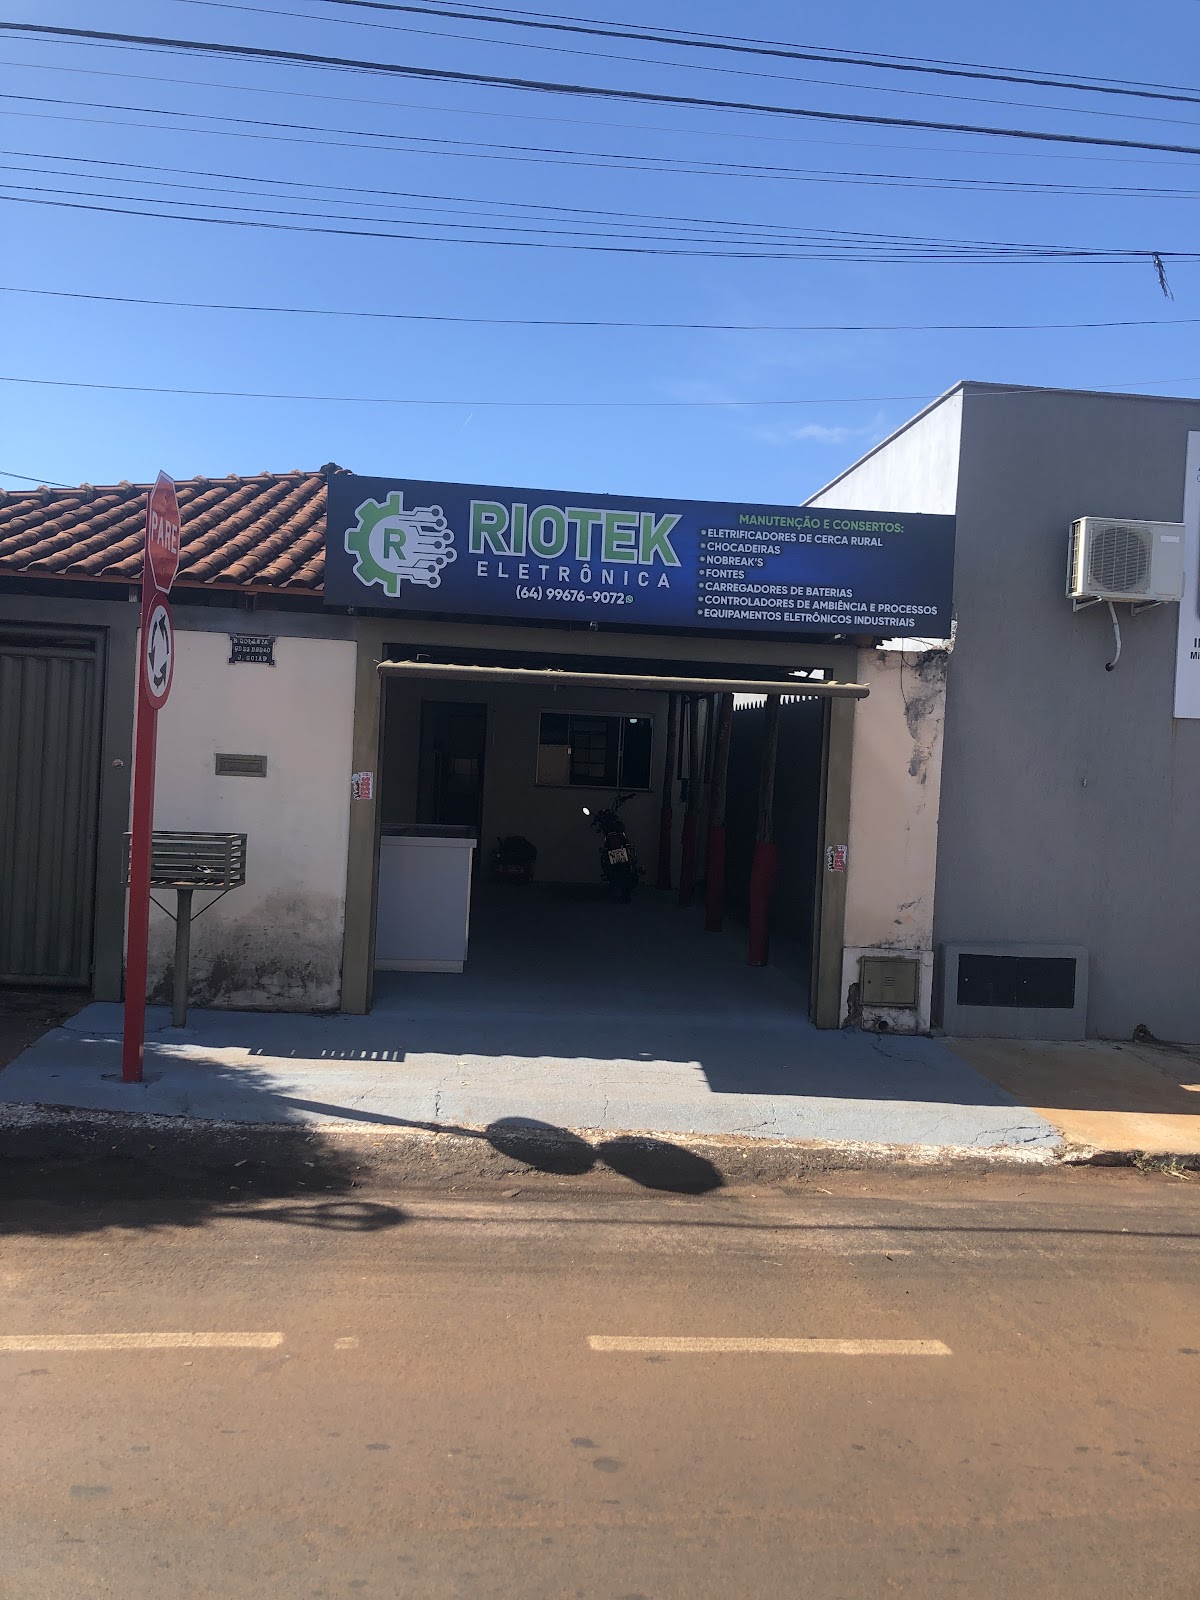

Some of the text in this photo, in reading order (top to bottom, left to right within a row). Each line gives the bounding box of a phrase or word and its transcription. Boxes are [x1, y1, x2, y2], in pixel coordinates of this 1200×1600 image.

[151, 510, 177, 554] PARE
[468, 499, 683, 567] RIOTEK
[739, 514, 904, 533] MANUTENÇÃO E CONSERTOS:
[383, 528, 407, 561] R
[707, 528, 883, 547] ELETRIFICADORES DE CERCA RURAL
[707, 541, 781, 555] CHOCADEIRAS
[706, 555, 764, 567] NOBREAK'S
[477, 560, 670, 588] ELETRÔNICA
[705, 568, 745, 580] FONTES
[516, 585, 625, 605] (64) 99676-9072
[705, 582, 853, 598] CARREGADORES DE BATERIAS
[704, 595, 938, 615] CONTROLADORES DE AMBIÊNCIA E PROCESSOS
[704, 608, 916, 627] EQUIPAMENTOS ELETRÔNICOS INDUSTRIAIS
